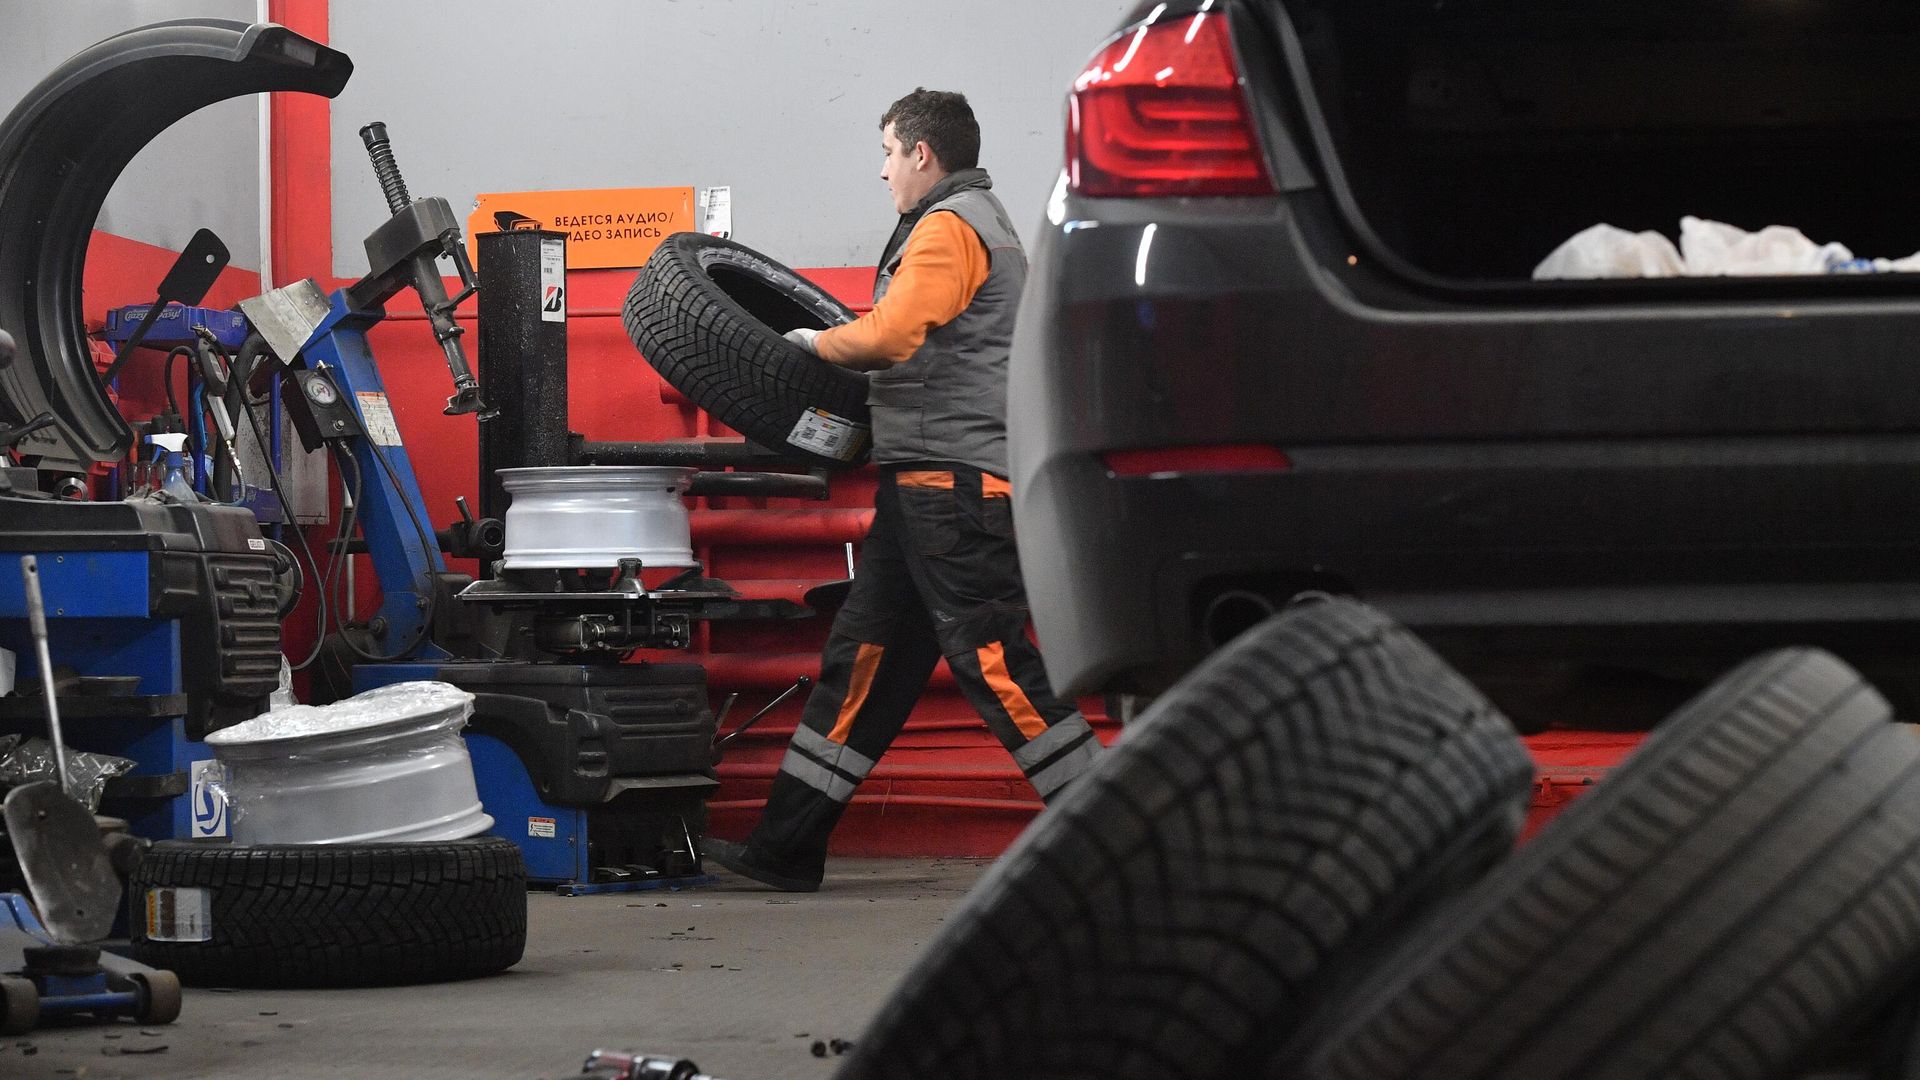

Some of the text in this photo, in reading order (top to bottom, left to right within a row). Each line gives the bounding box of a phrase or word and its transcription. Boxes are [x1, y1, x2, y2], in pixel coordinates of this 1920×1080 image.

[555, 212, 673, 227] ВЕДЕТСЯ АУДИО/
[565, 228, 661, 242] ИДЕО ЗАПИСЬ
